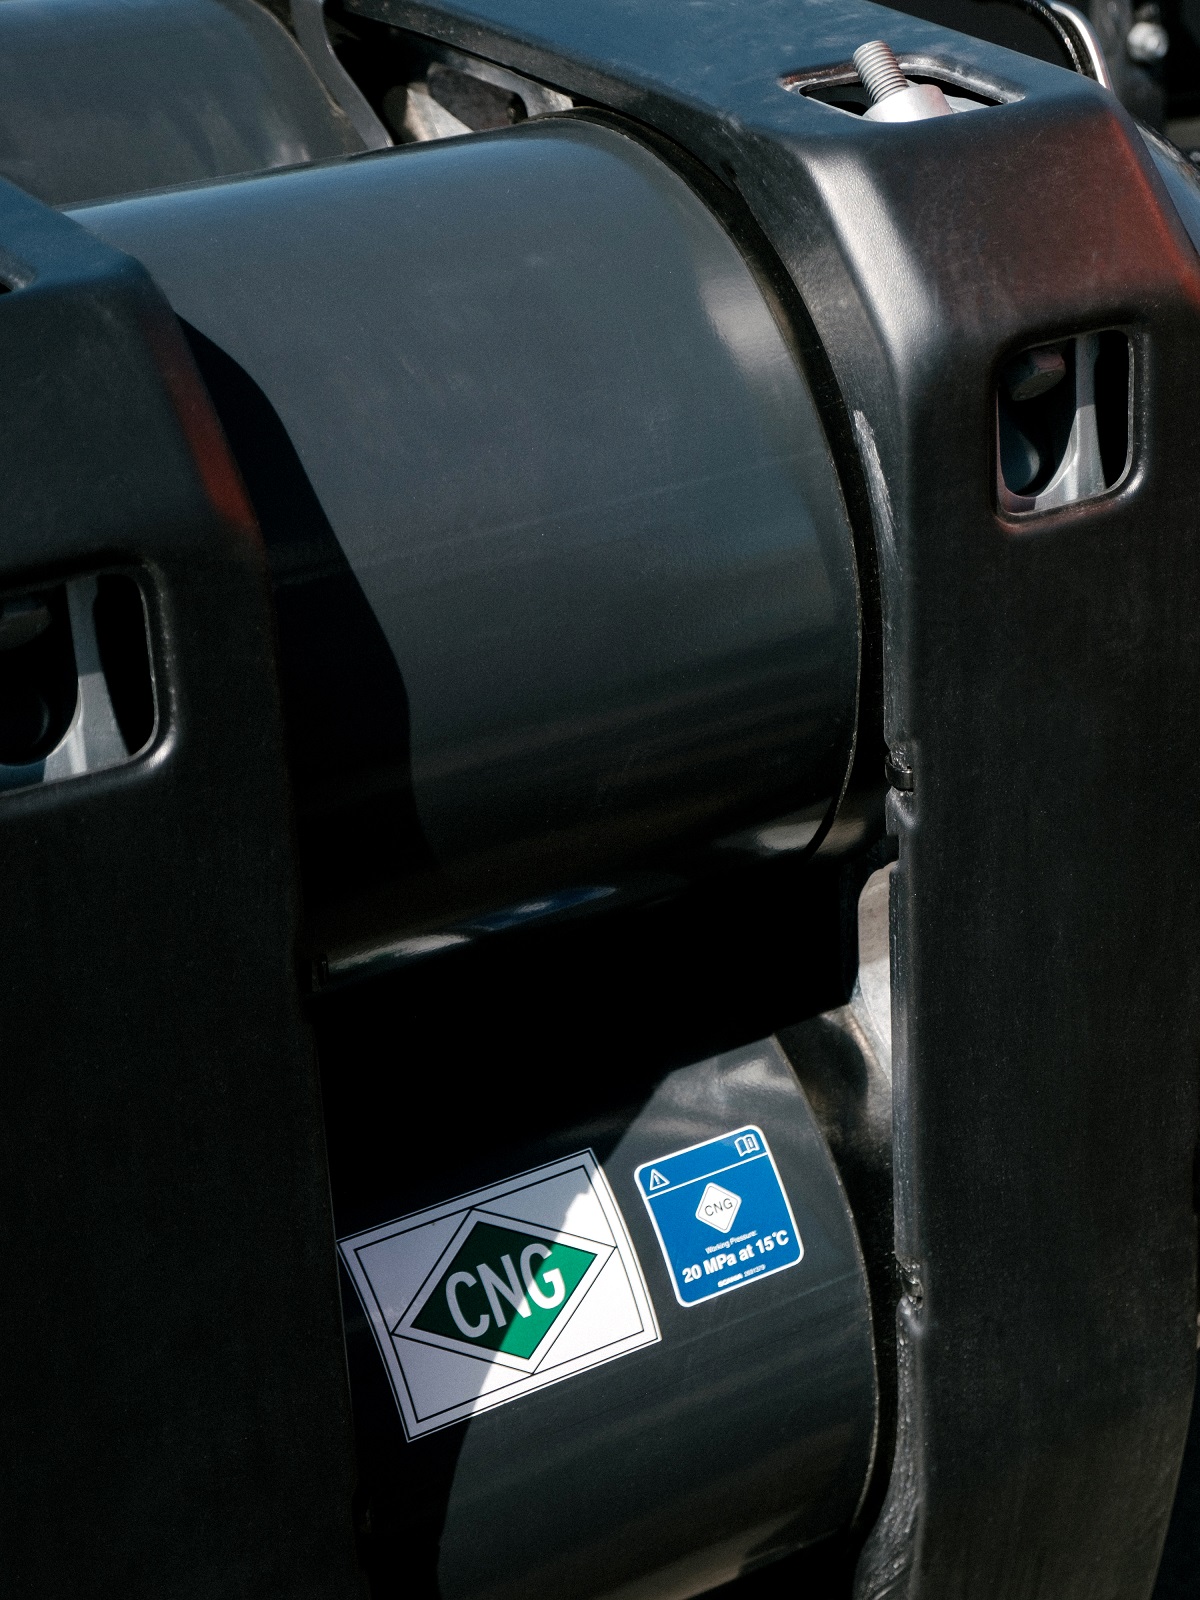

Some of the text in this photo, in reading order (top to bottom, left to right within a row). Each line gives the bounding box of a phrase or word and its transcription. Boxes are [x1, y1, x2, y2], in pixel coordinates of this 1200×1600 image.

[704, 1197, 734, 1217] CNG
[682, 1264, 702, 1283] 20
[703, 1252, 737, 1275] MPa
[739, 1244, 756, 1262] at
[756, 1230, 789, 1253] 15°C
[704, 1238, 731, 1254] Working
[445, 1243, 567, 1338] CNG
